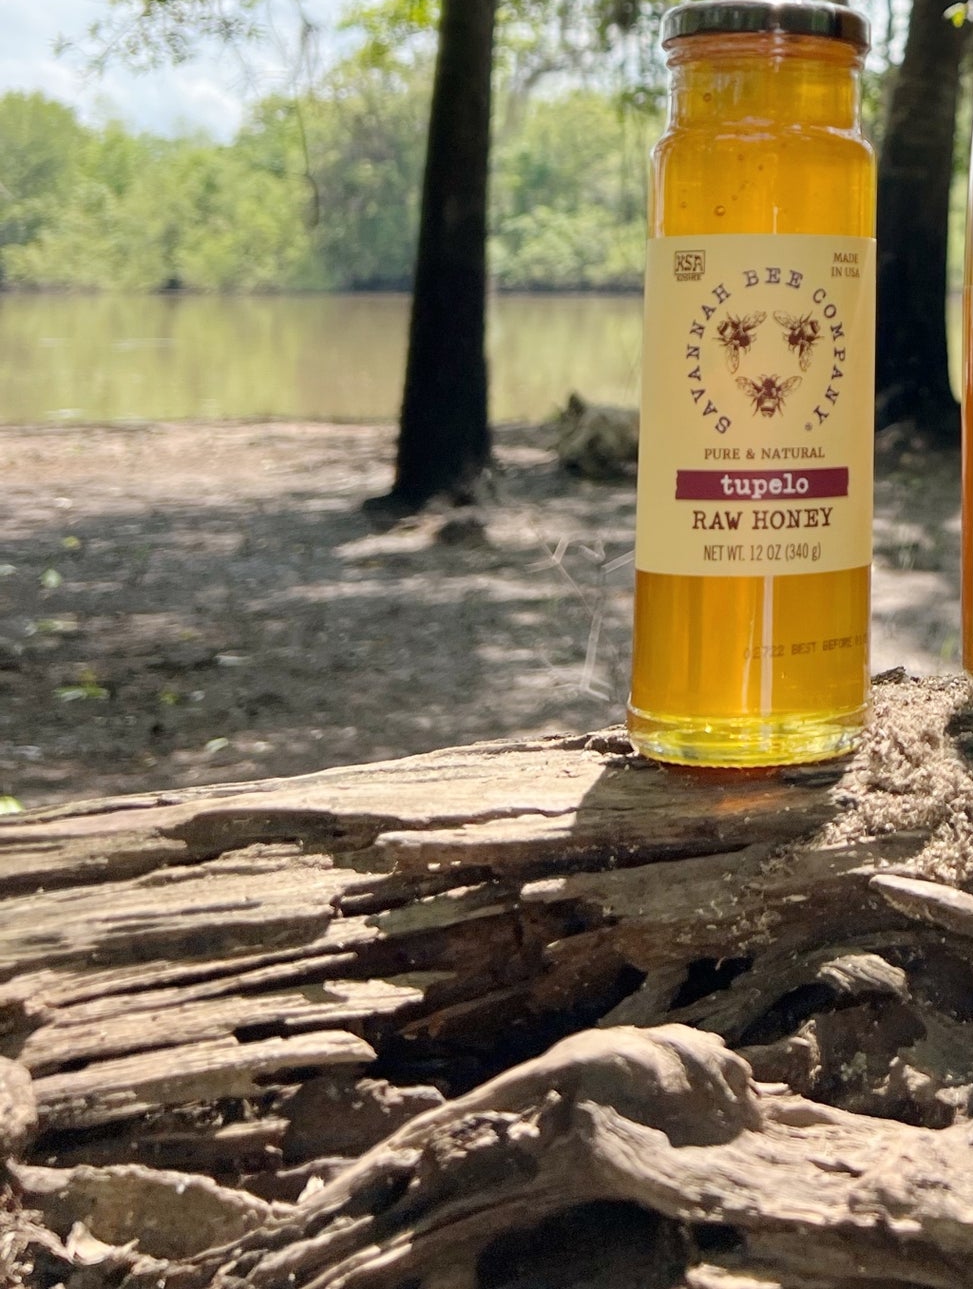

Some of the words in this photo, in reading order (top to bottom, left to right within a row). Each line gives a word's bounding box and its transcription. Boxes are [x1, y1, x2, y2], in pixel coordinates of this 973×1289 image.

[833, 253, 859, 264] MADE
[832, 267, 842, 277] IN
[845, 267, 860, 278] USA
[686, 283, 732, 434] SAVANNAH
[743, 267, 804, 289] BEE
[812, 288, 846, 424] COMPANY
[704, 448, 741, 460] PURE
[746, 448, 755, 459] &
[760, 447, 825, 459] NATURAL
[720, 473, 809, 499] tupelo
[692, 510, 743, 530] RAW
[752, 507, 834, 530] HONEY
[703, 545, 724, 561] NET
[727, 545, 745, 561] WT.
[750, 545, 763, 561] 12
[767, 544, 782, 561] OZ
[785, 543, 809, 562] (340
[812, 542, 821, 561] g)
[791, 642, 816, 655] BEST
[822, 637, 852, 651] BEFORE
